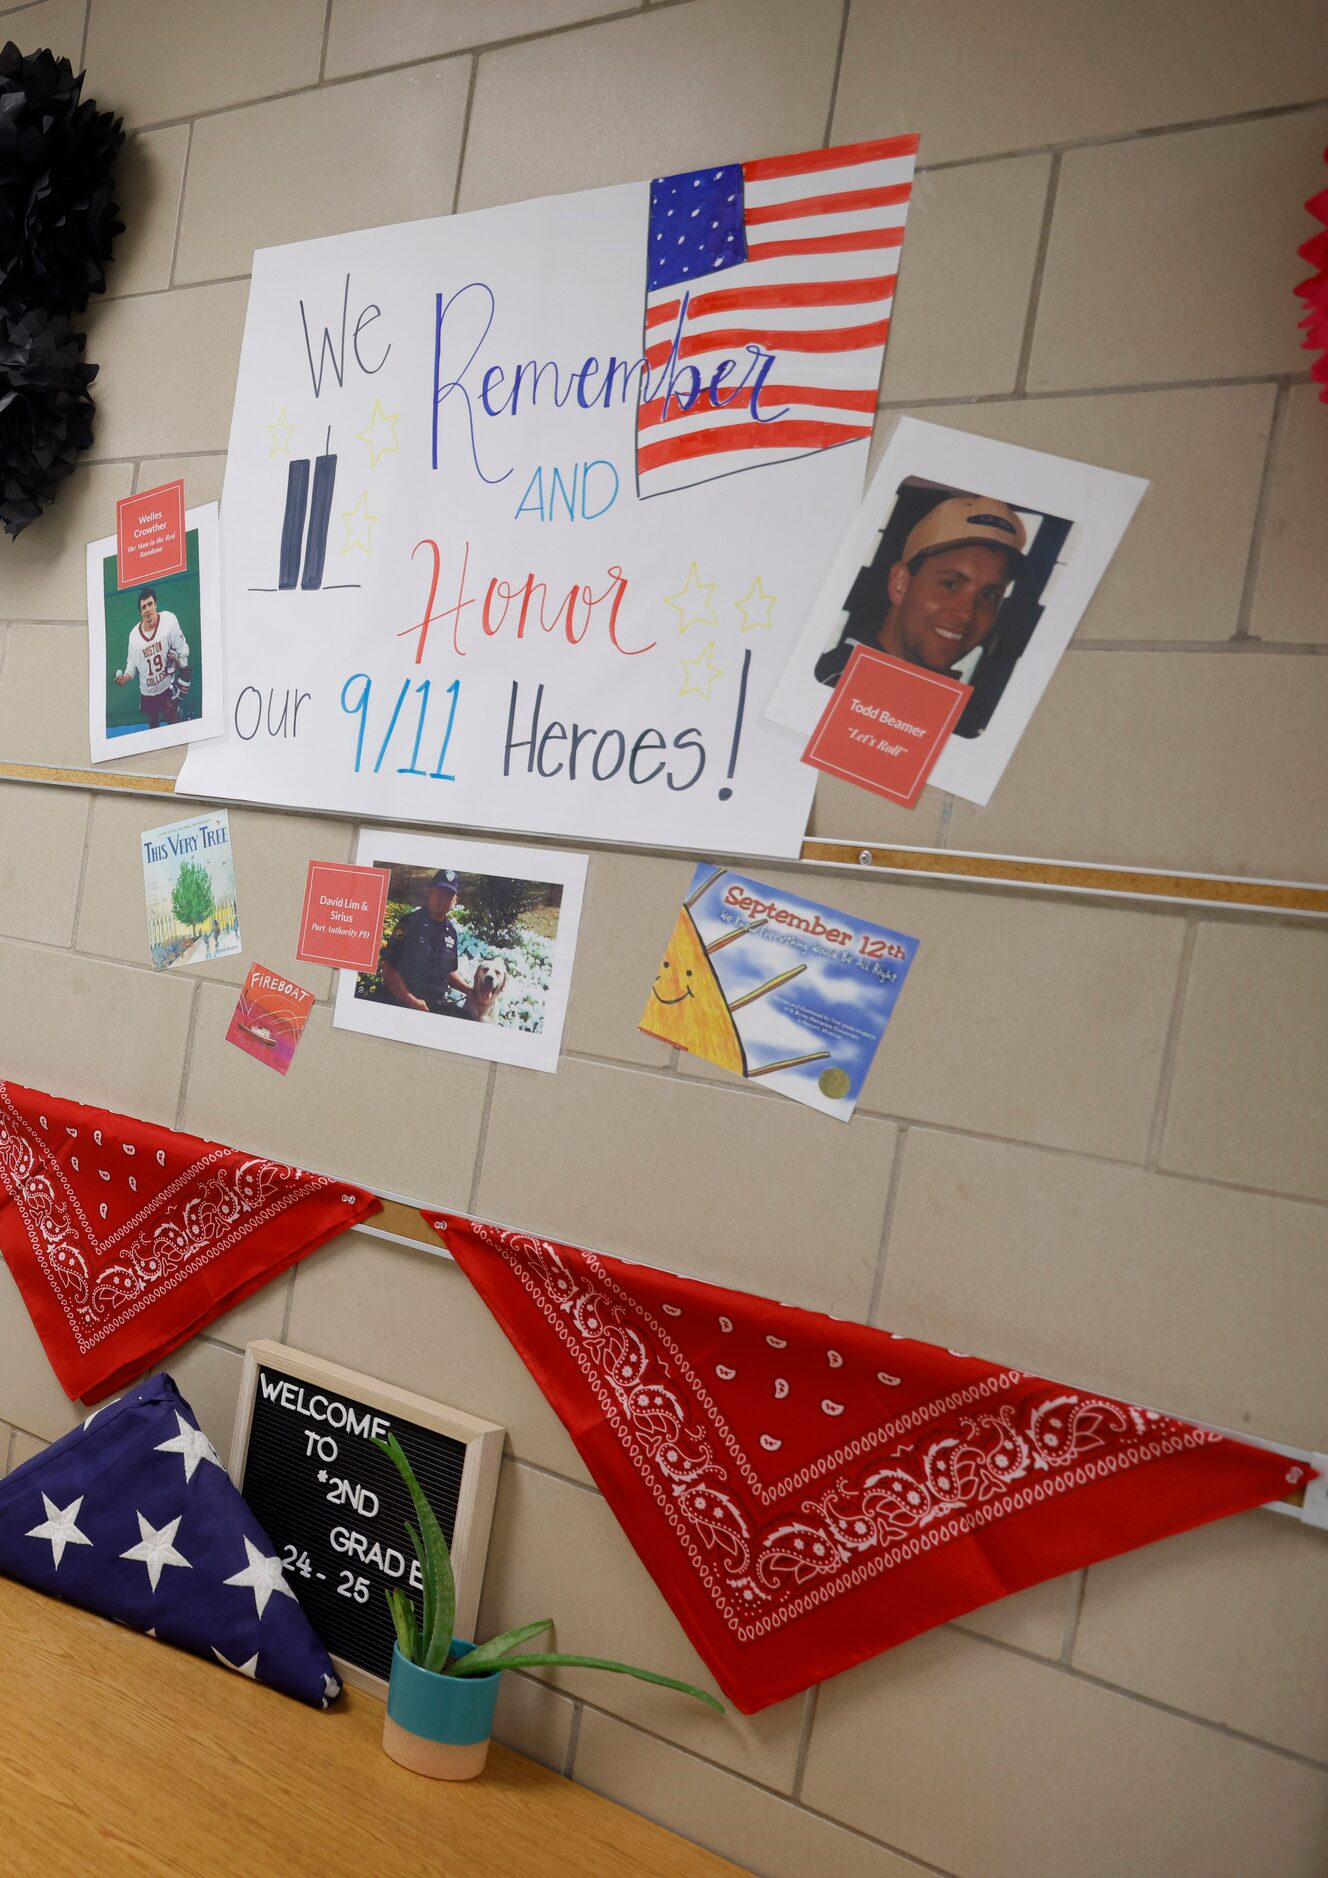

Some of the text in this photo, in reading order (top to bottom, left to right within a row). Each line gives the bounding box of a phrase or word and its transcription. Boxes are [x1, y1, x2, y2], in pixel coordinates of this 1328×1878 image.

[299, 272, 791, 485] We Remember
[514, 460, 620, 522] AND
[133, 521, 168, 539] Crowther
[137, 511, 163, 526] Welles
[397, 538, 658, 665] Honor
[147, 654, 163, 676] 19
[234, 648, 752, 802] our 9/11 Heroes!
[849, 698, 927, 738] Todd Beamer
[144, 841, 168, 864] THIS
[167, 833, 199, 857] VERY
[199, 826, 228, 849] TREE
[319, 895, 368, 911] David Lim &
[330, 911, 353, 923] Sirius
[719, 909, 734, 924] We
[311, 922, 371, 939] Port Authority PD
[723, 885, 907, 961] September 12th
[259, 1372, 391, 1446] WELCOME
[303, 1428, 338, 1464] TO
